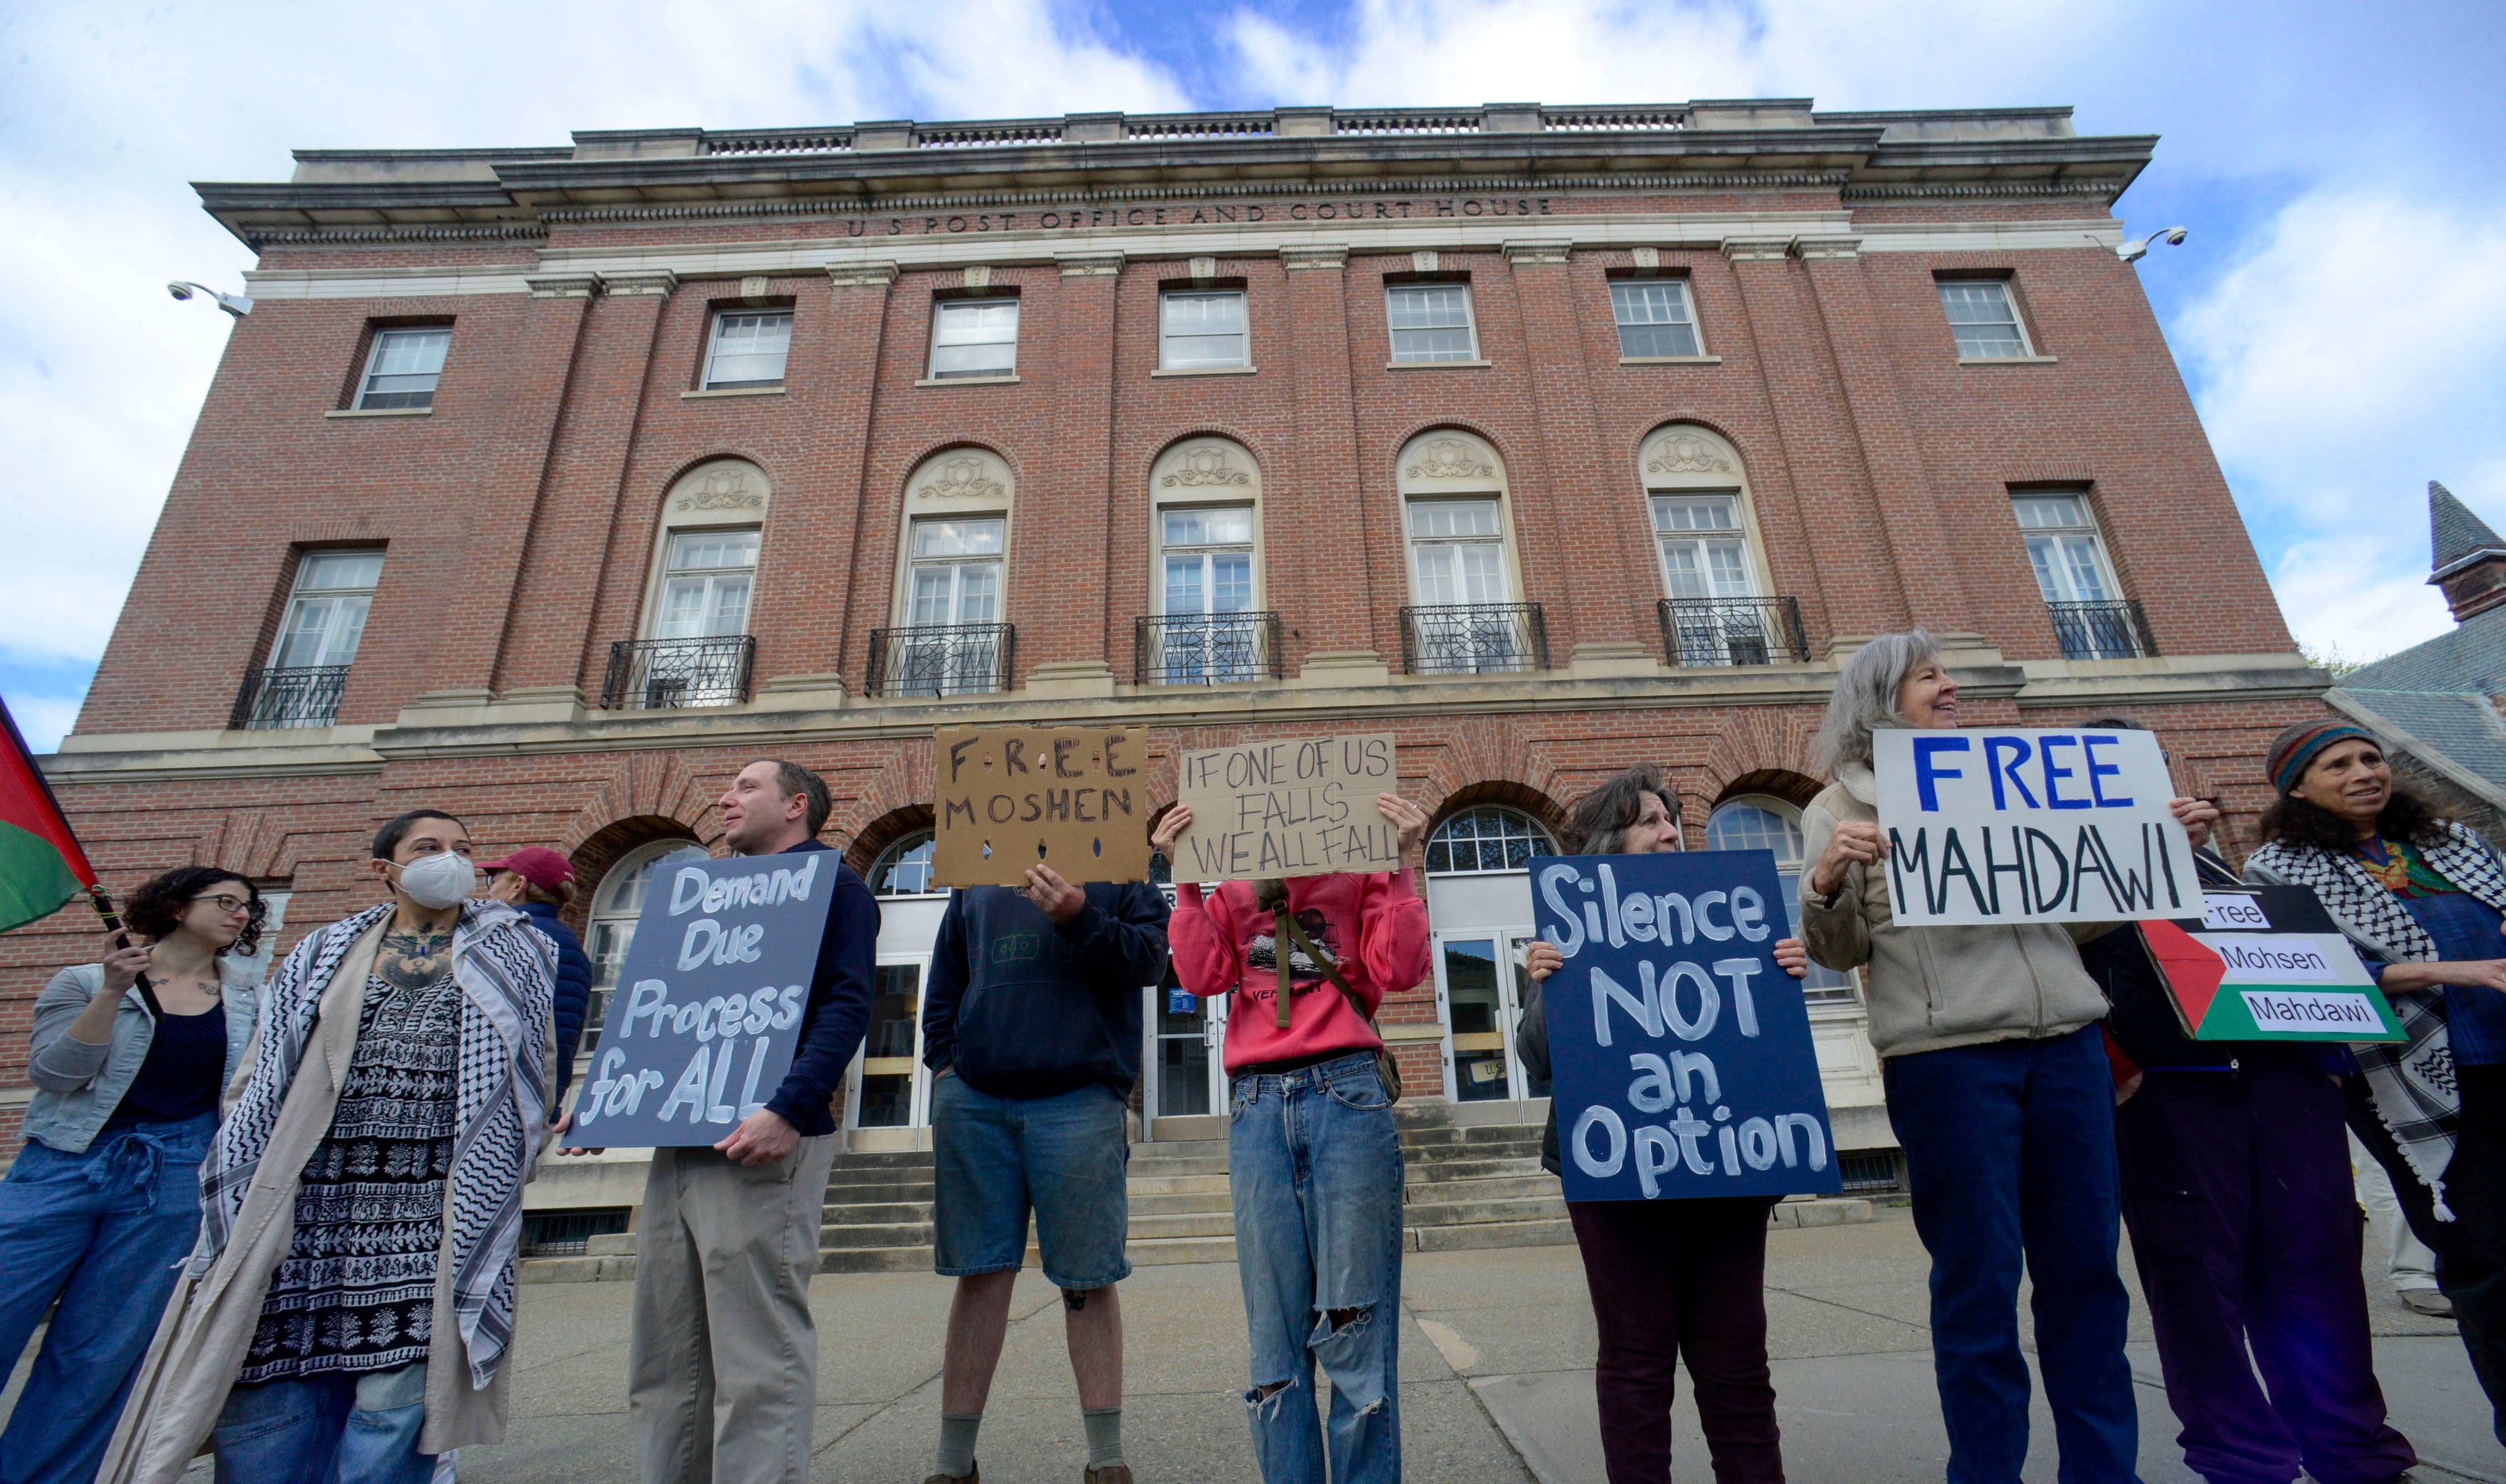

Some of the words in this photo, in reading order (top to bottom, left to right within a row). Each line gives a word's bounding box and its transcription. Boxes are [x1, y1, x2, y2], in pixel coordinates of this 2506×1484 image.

[924, 214, 1015, 234] POST
[1040, 209, 1167, 229] OFFICE
[1191, 205, 1265, 223] AND
[1291, 202, 1411, 220] COURT
[1435, 199, 1552, 217] HOUSE
[950, 734, 1137, 783] FREE
[1187, 753, 1220, 788] IF
[1226, 744, 1287, 788] ONE
[1297, 740, 1335, 779] OF
[1344, 739, 1389, 776] US
[1913, 735, 2134, 811] FREE
[945, 788, 1132, 830] MOSHEN
[1236, 782, 1349, 830] FALLS
[1190, 831, 1254, 874] WE
[1259, 831, 1318, 871] ALL
[1316, 824, 1399, 865] FALL
[1888, 823, 2182, 915] MAHDAWI
[668, 854, 820, 916] Demand
[1538, 863, 1771, 959] Silence
[676, 918, 764, 971] Due
[2219, 946, 2327, 970] Mohsen
[619, 979, 804, 1042] Process
[1590, 957, 1762, 1047] NOT
[2247, 996, 2372, 1022] Mahdawi
[579, 1046, 664, 1126] for
[656, 1036, 770, 1124] ALL
[1627, 1050, 1721, 1113] an
[1572, 1105, 1827, 1199] Option
